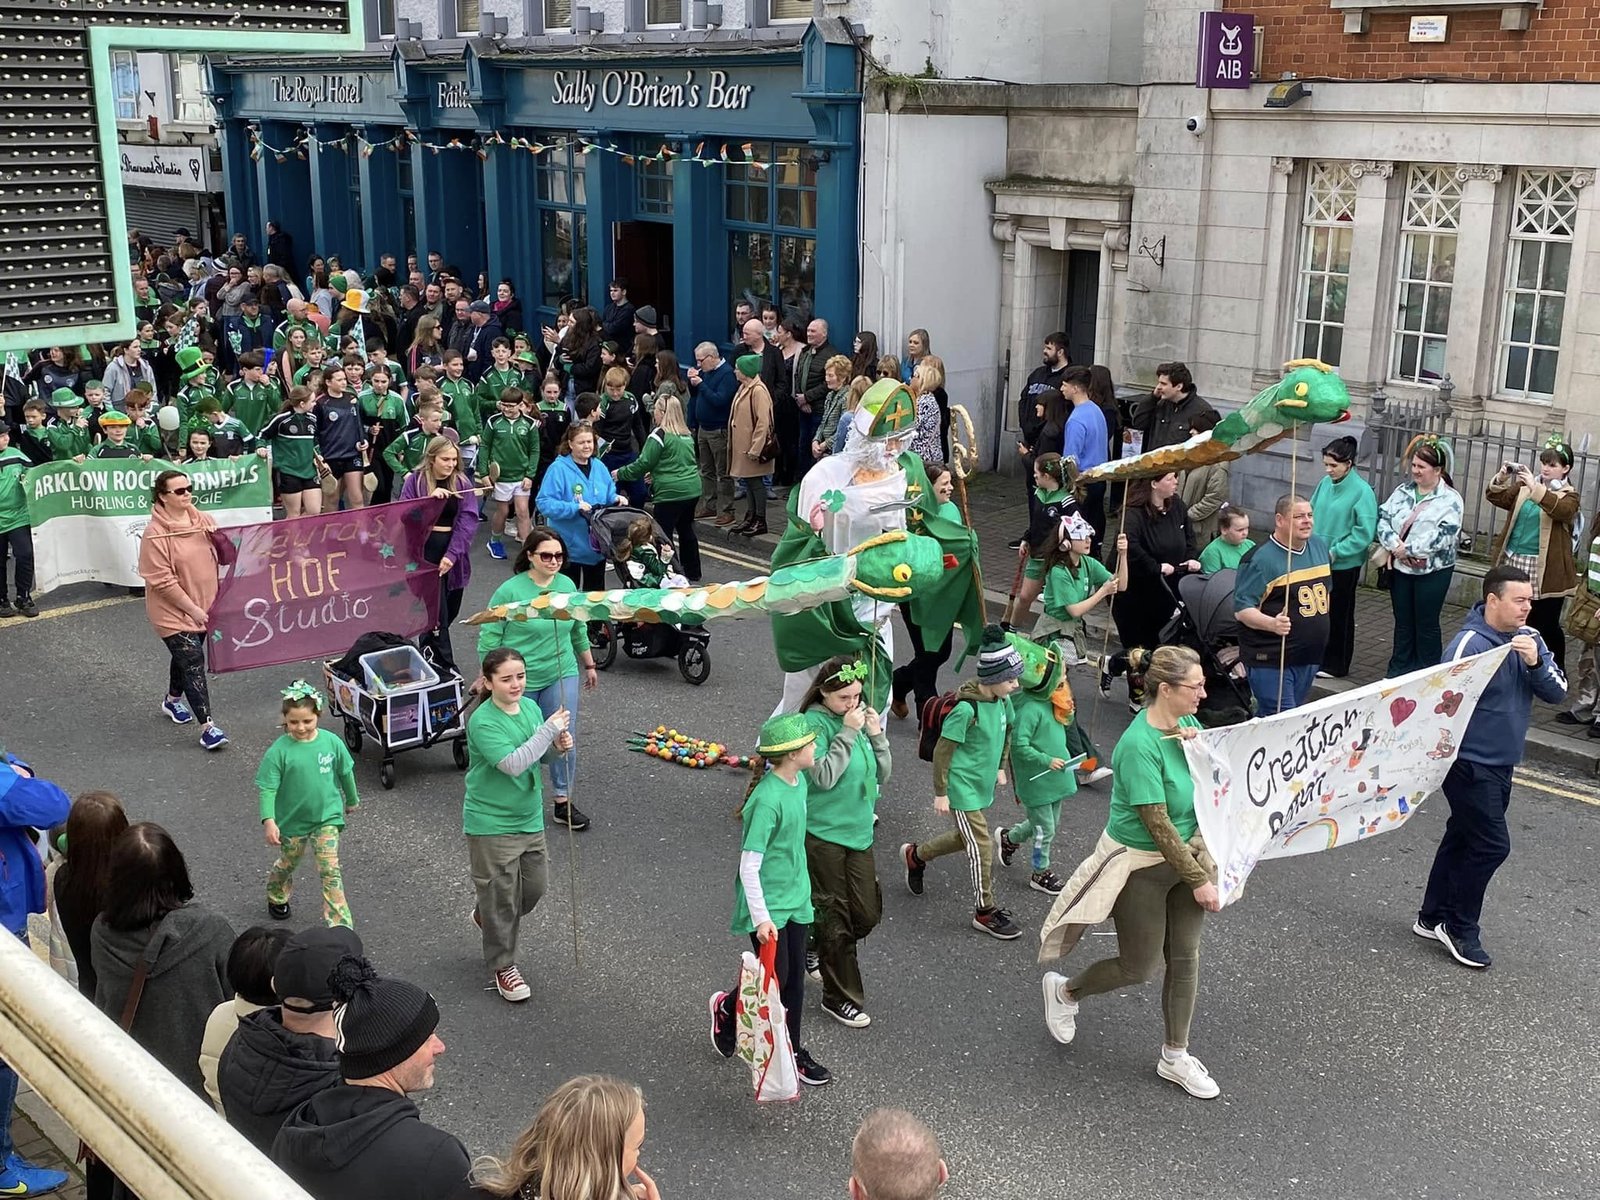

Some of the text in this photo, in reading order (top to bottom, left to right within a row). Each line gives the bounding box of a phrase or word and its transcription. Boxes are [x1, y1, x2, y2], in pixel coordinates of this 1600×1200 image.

[1216, 59, 1242, 79] AIB
[271, 75, 364, 108] The Royal Hotel
[437, 81, 472, 108] Fáilt
[552, 70, 752, 112] Sally O'Brien's Bar
[35, 470, 108, 499] ARKLOW
[71, 495, 135, 510] HURLING
[137, 495, 148, 509] &
[269, 551, 347, 603] HOF
[1298, 582, 1328, 618] 98
[232, 592, 373, 652] Studio
[1246, 709, 1359, 808] Creation
